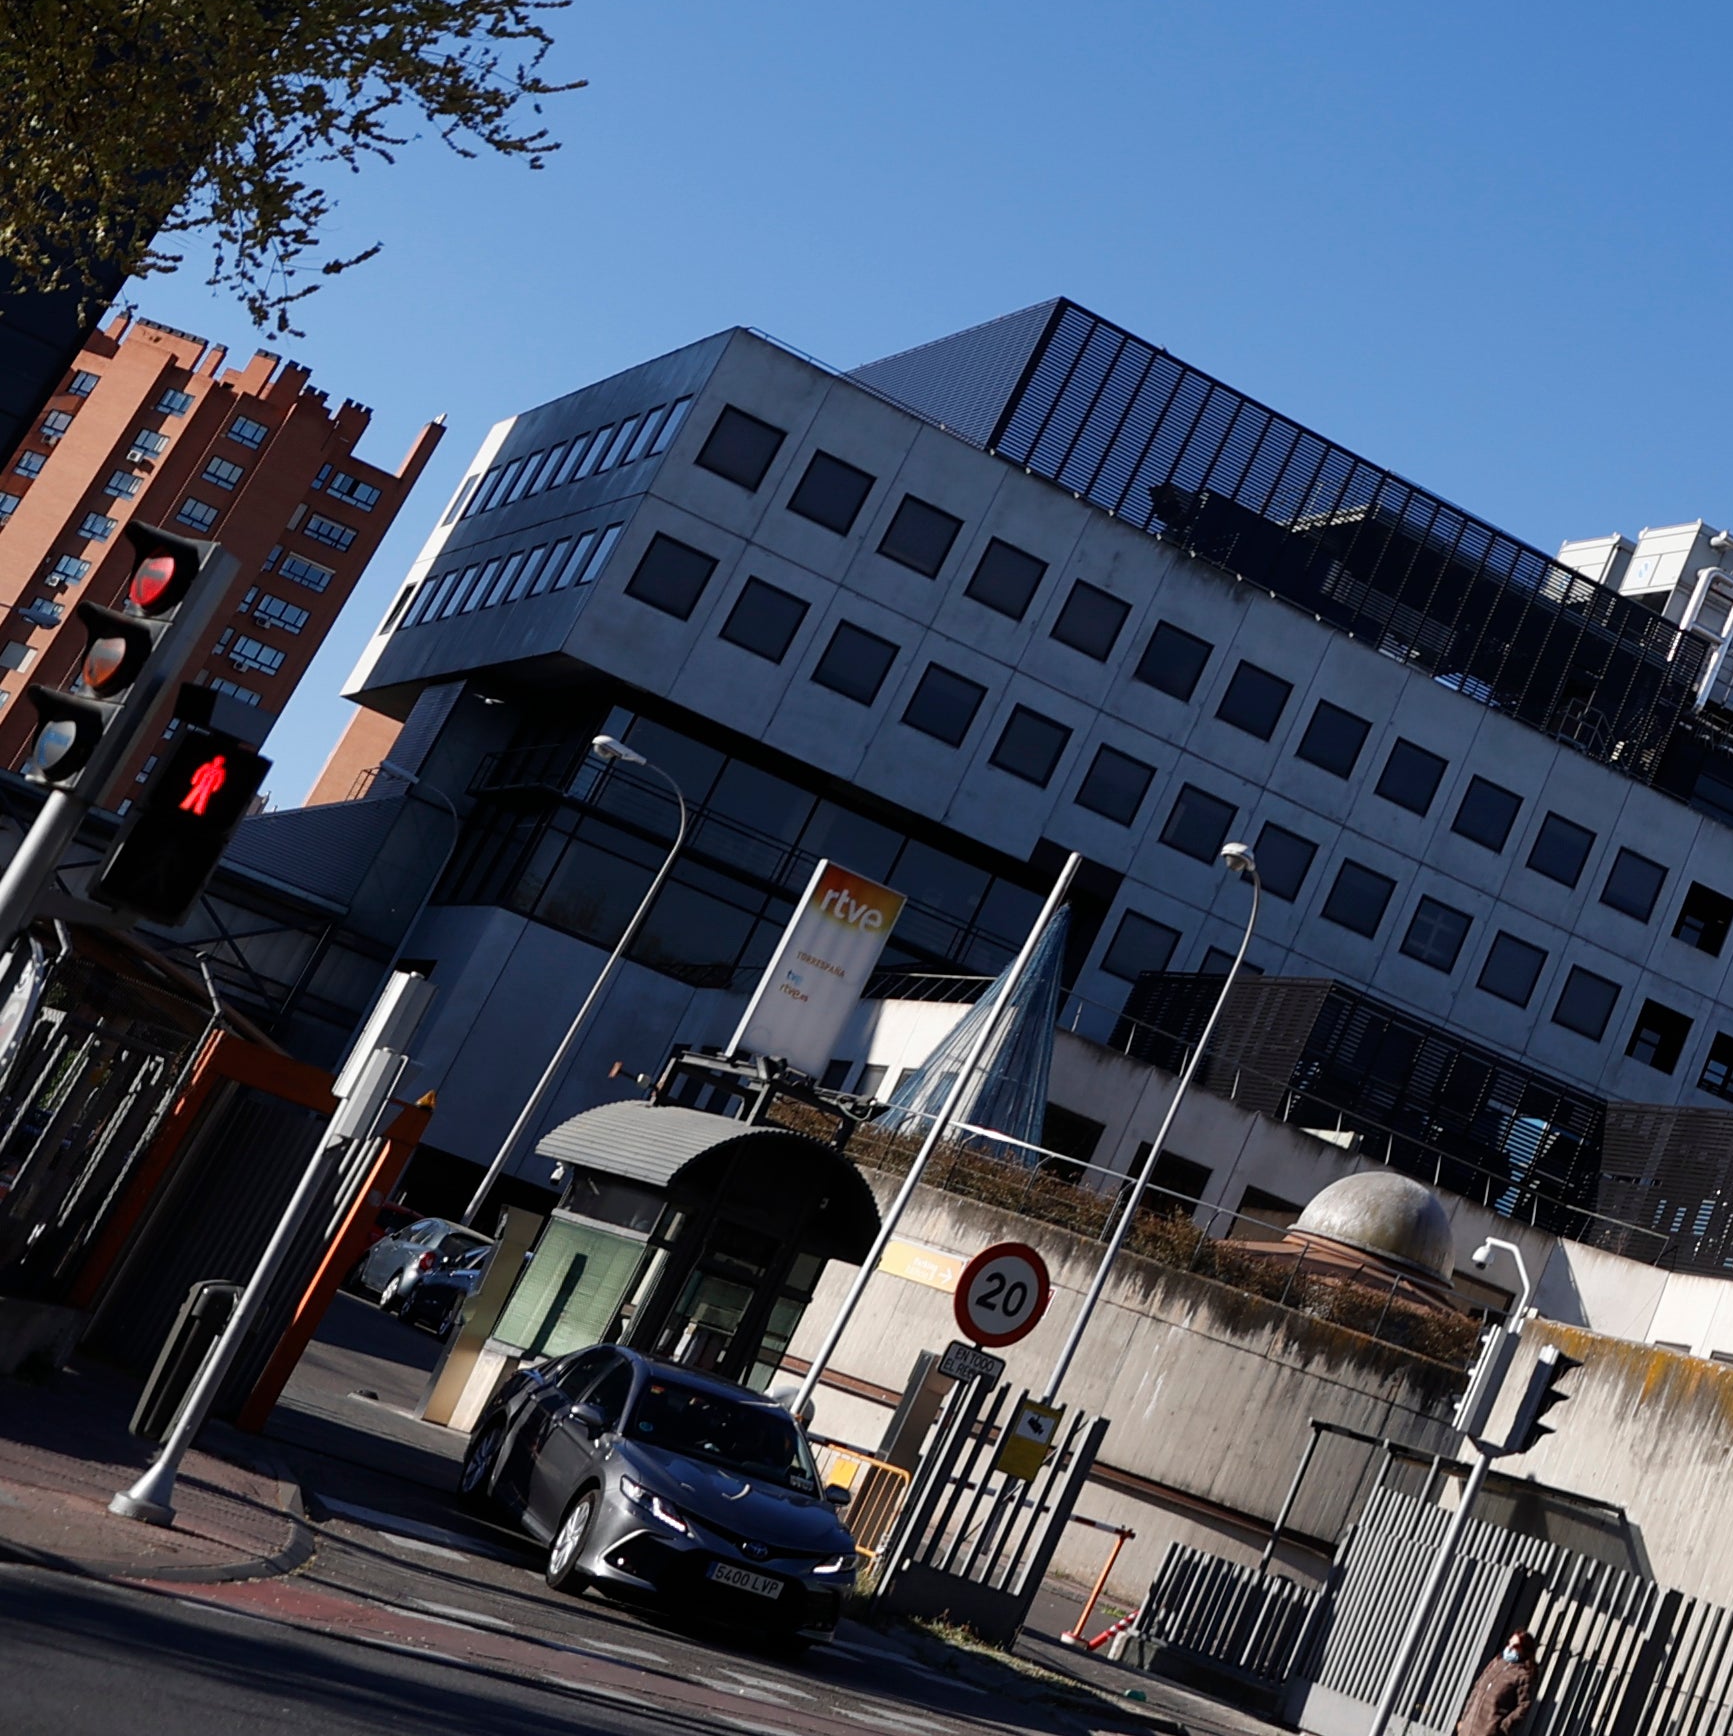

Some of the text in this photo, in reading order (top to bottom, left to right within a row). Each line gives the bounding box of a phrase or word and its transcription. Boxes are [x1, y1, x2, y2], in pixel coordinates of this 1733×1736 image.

[820, 889, 883, 932] rtve
[797, 951, 846, 978] TORRESPAÑA
[975, 1272, 1028, 1317] 20
[944, 1358, 955, 1371] EL
[955, 1347, 971, 1362] EN
[970, 1352, 995, 1372] TODO
[715, 1566, 779, 1594] 5400 LVP
